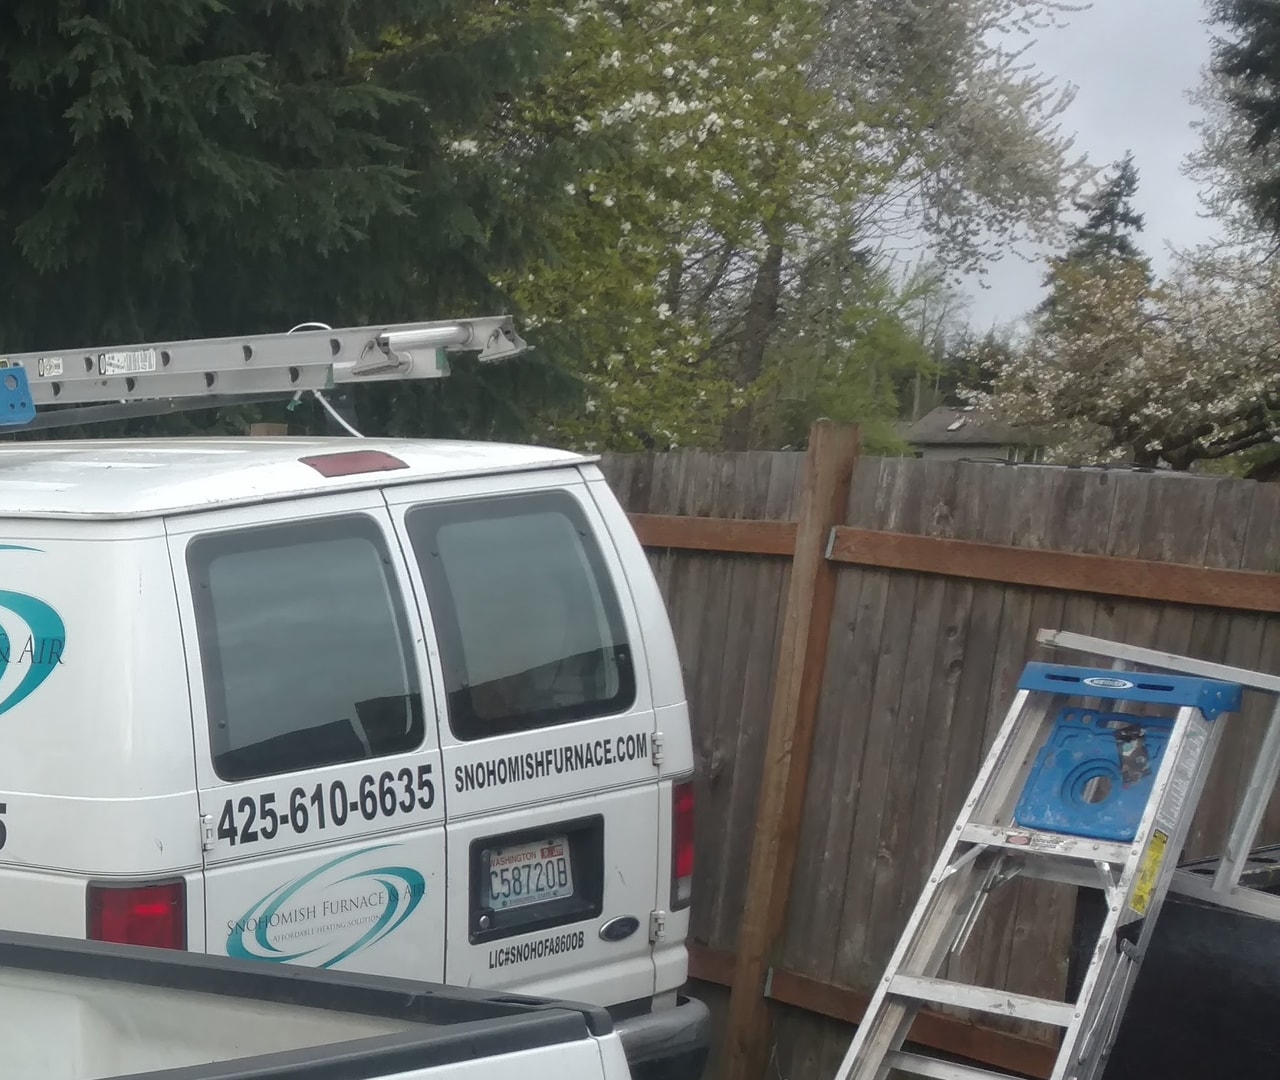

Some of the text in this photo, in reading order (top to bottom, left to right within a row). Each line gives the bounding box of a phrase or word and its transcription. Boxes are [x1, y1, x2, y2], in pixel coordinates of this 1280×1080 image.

[16, 633, 66, 665] AIR
[455, 732, 648, 793] SNOHOMISHFURNACE.COM
[217, 763, 435, 847] 425-610-6635
[490, 853, 537, 867] WASHINGTON
[490, 857, 568, 900] C58720B
[226, 905, 316, 936] SNOHOMISH
[322, 891, 384, 916] FURNACE
